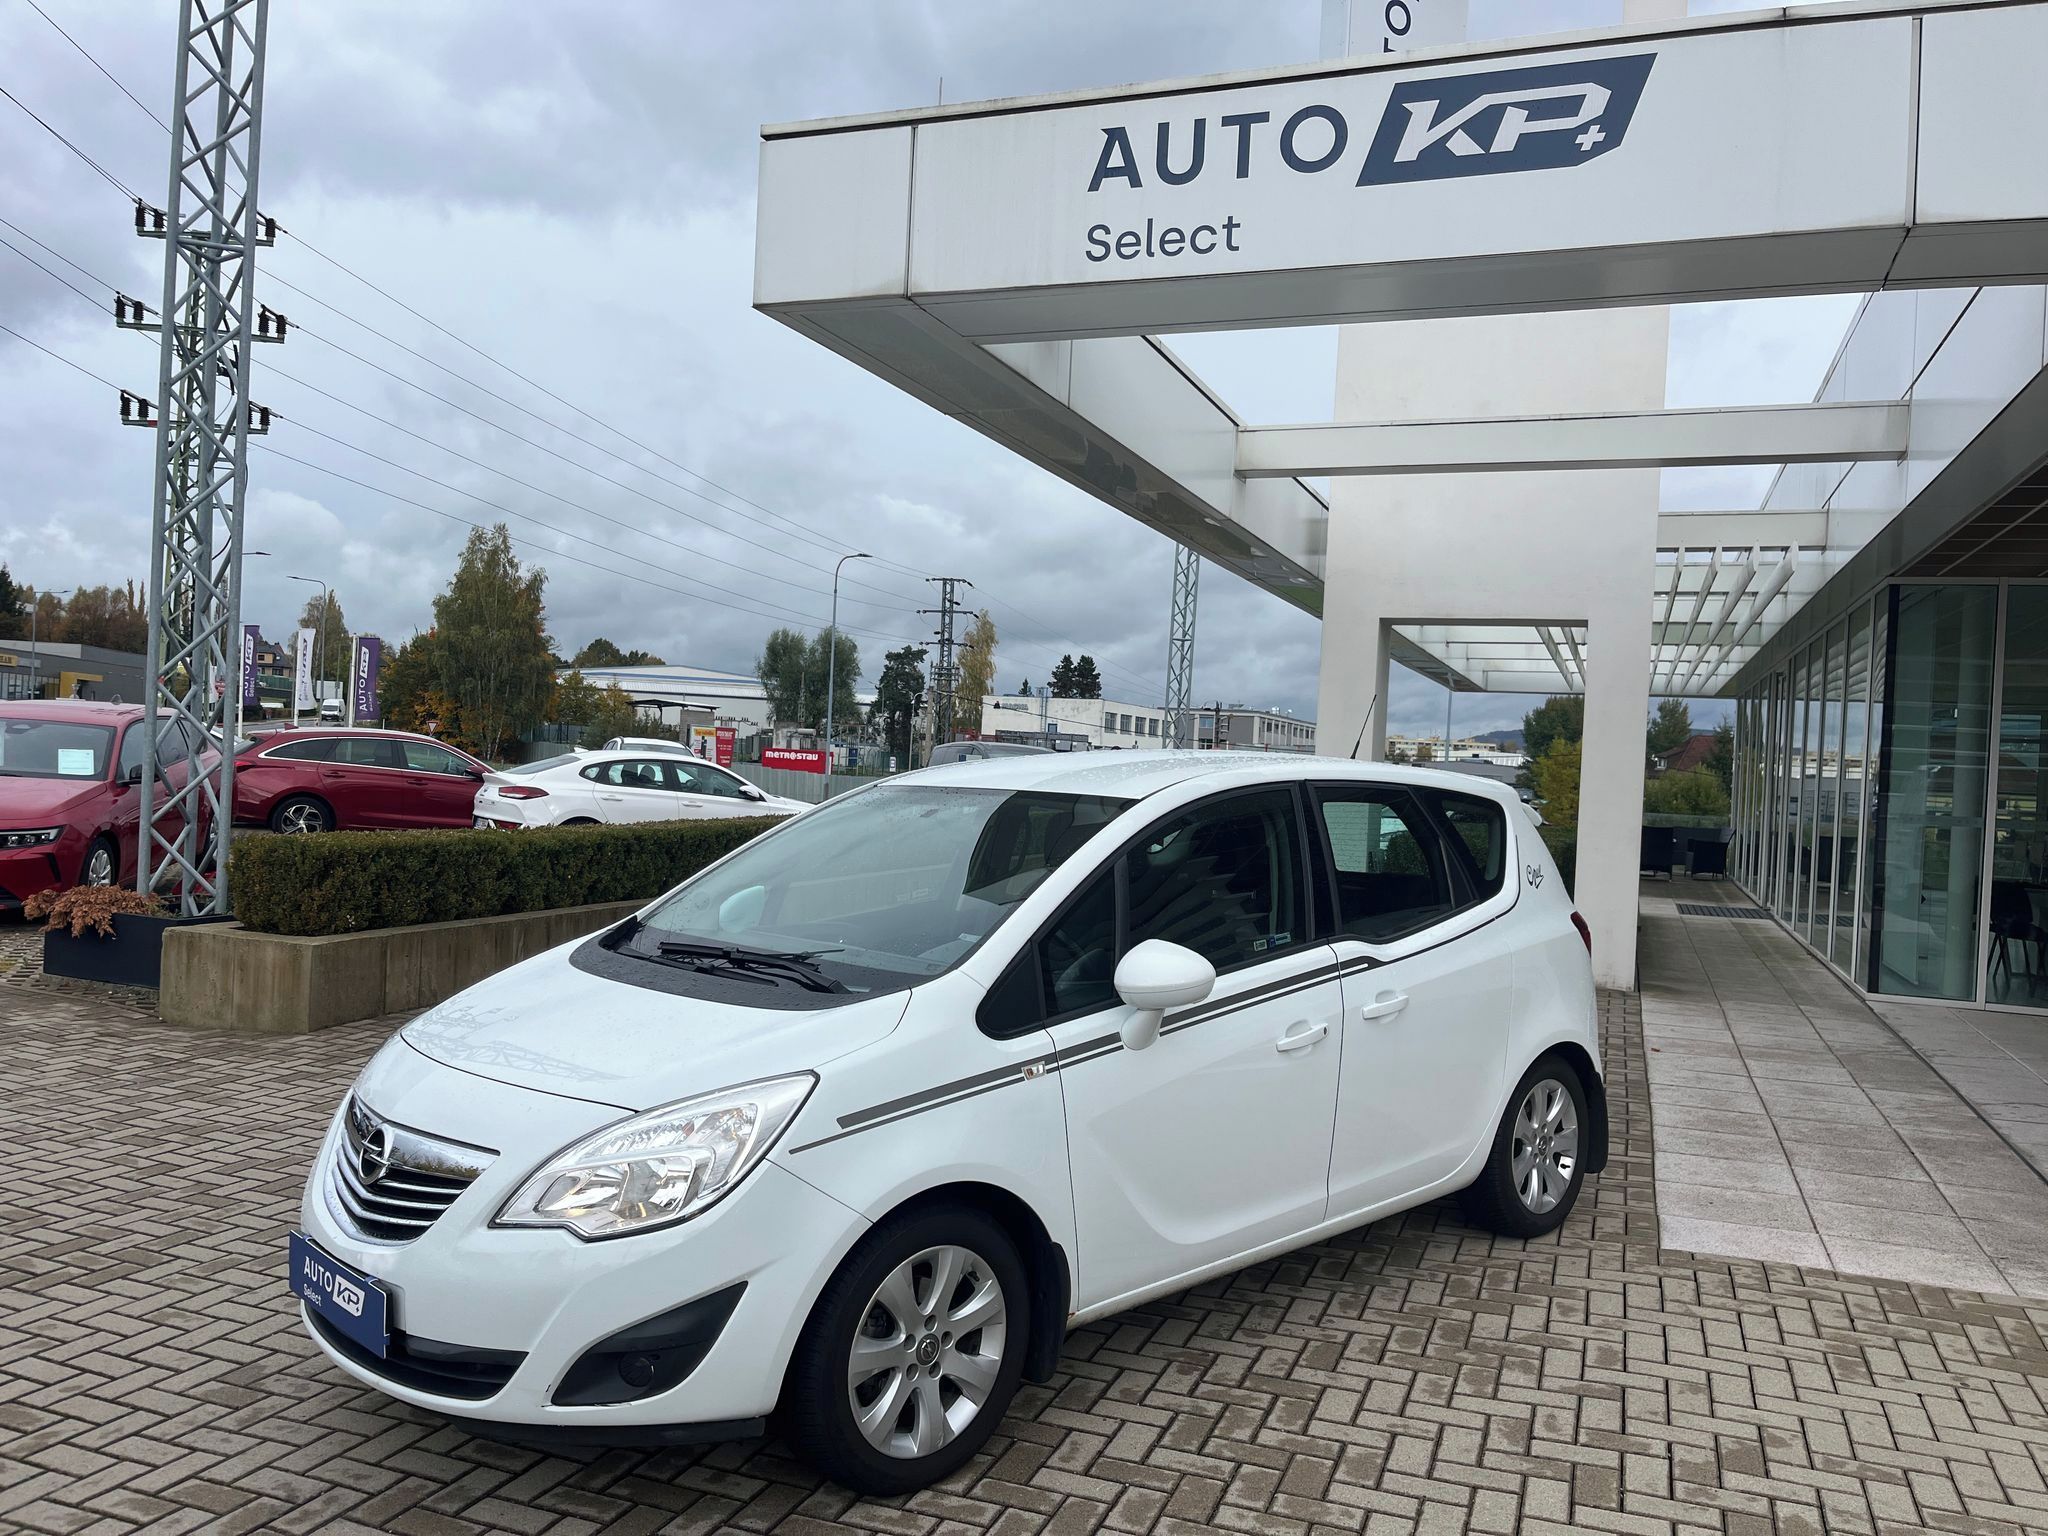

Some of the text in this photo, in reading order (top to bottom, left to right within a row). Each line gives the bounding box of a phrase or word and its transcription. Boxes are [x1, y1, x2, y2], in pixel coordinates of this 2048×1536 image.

[1087, 105, 1349, 192] AUTO
[1085, 215, 1241, 262] Select
[359, 680, 368, 712] AUTO
[303, 1256, 333, 1292] AUTO
[303, 1283, 323, 1307] Select
